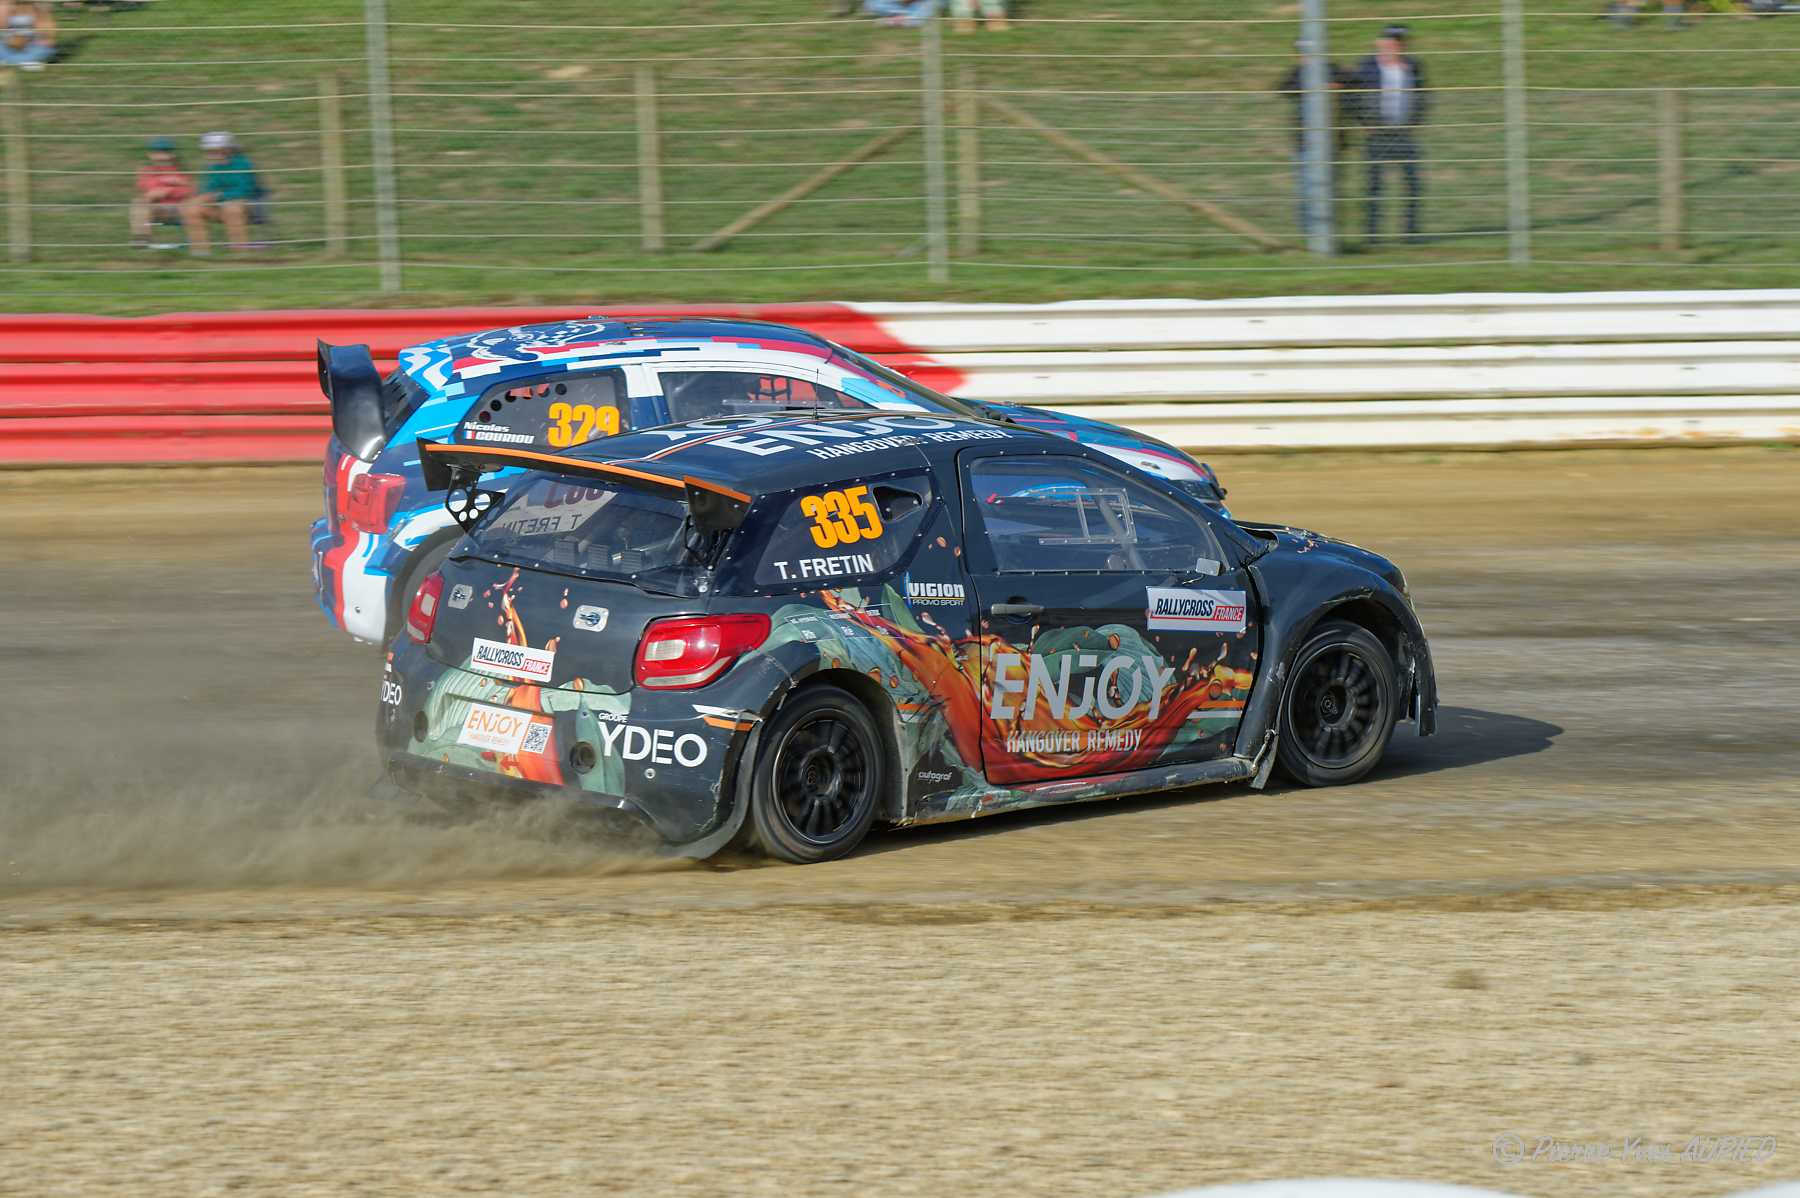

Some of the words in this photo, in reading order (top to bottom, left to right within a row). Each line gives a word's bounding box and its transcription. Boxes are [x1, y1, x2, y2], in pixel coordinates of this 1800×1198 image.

[464, 421, 511, 432] Nicolas
[476, 431, 535, 444] COURIOU
[548, 402, 620, 448] 329
[921, 429, 1013, 443] REMEDY
[801, 485, 883, 549] 335
[773, 561, 797, 580] T.
[799, 554, 874, 578] FRETIN
[1155, 598, 1214, 617] RALLYCROSS
[1214, 607, 1244, 621] FRANCE
[476, 645, 524, 667] RALLYCROSS
[523, 660, 551, 674] FRANCE
[990, 654, 1175, 720] ENJOY
[466, 709, 524, 738] ENJOY
[598, 712, 628, 723] GROUPE
[597, 721, 708, 768] YDEO
[1006, 731, 1080, 753] HANGOVER
[1087, 729, 1143, 752] REMEDY
